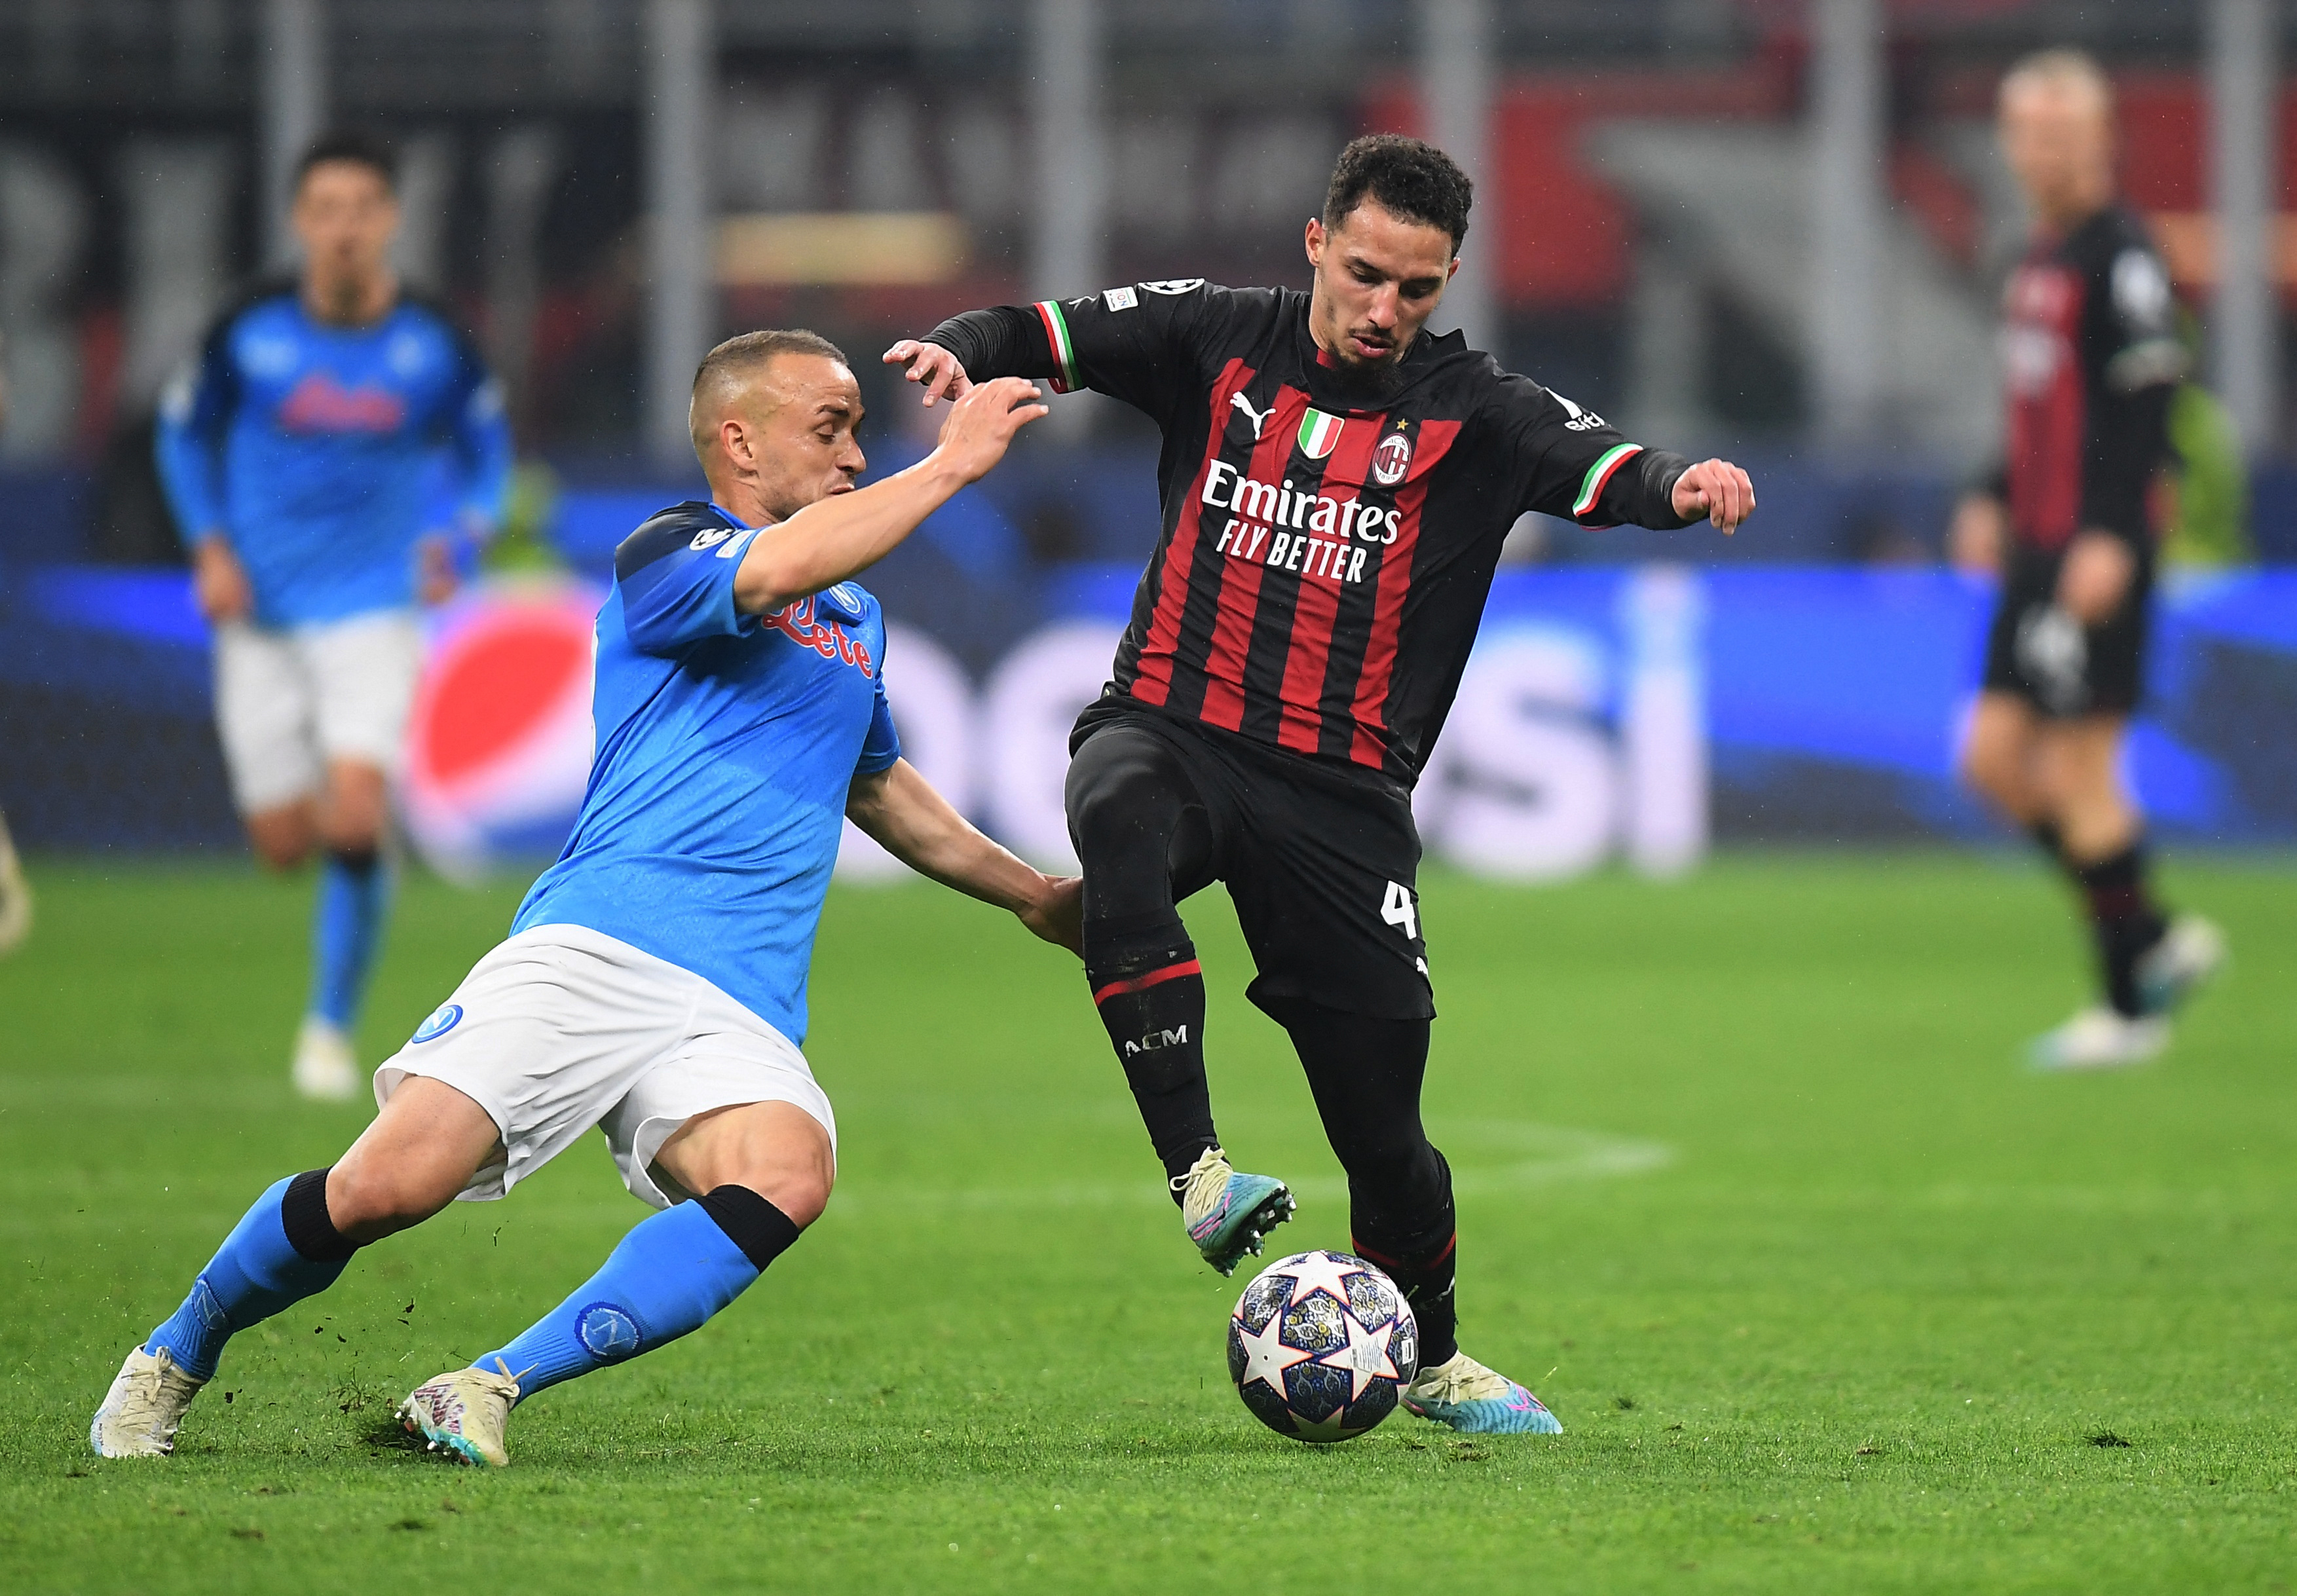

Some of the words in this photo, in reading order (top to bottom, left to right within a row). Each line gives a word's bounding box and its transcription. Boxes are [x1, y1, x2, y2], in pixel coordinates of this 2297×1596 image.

[1386, 437, 1406, 449] ACM
[1201, 458, 1402, 545] Emirates
[1378, 472, 1395, 481] 1899
[1216, 518, 1268, 560] FLY
[1266, 531, 1368, 584] BETTER
[761, 594, 873, 680] Lete
[1380, 880, 1417, 940] 4
[1125, 1024, 1188, 1058] ACM
